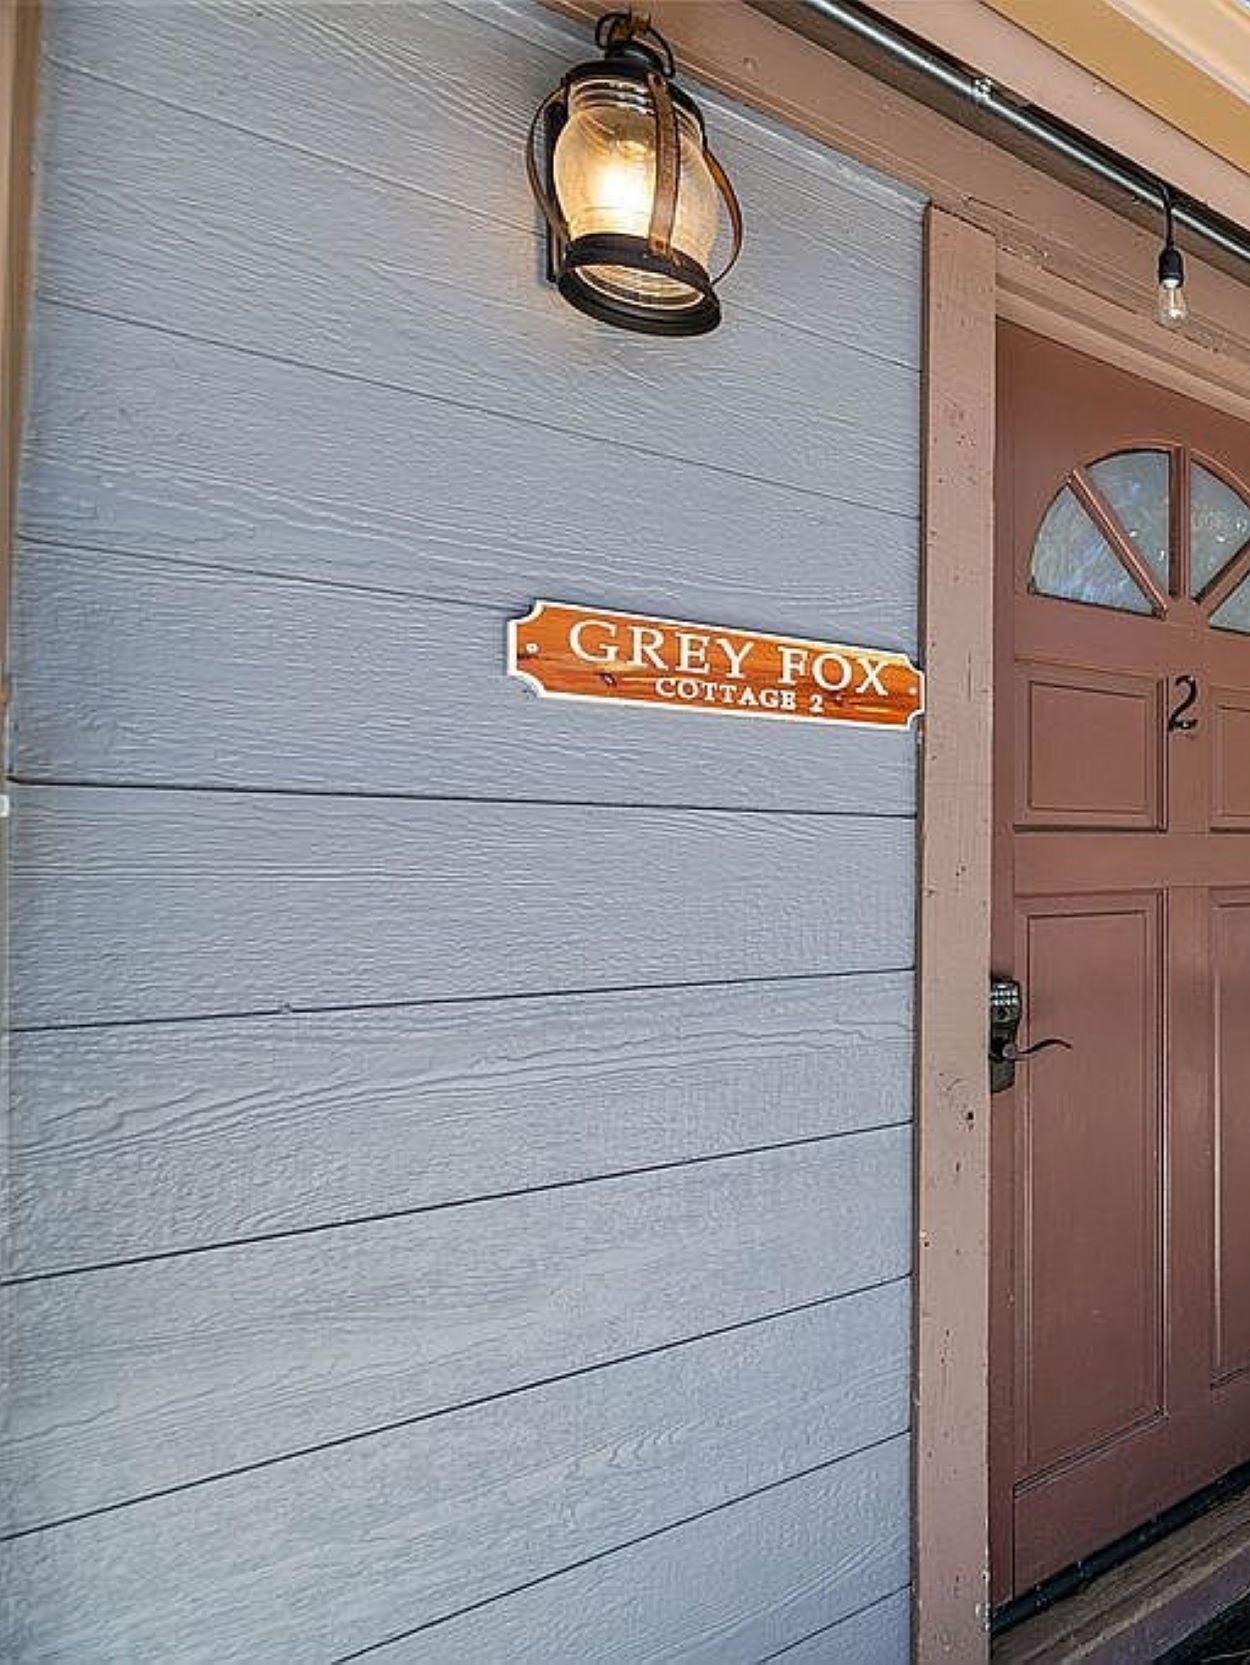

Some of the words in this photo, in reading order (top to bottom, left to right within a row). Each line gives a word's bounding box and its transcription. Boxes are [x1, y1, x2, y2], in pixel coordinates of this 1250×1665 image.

[568, 618, 756, 680] GREY
[777, 644, 890, 697] FOX
[654, 677, 798, 711] COTTAGE
[808, 694, 826, 714] 2
[1167, 675, 1198, 732] 2
